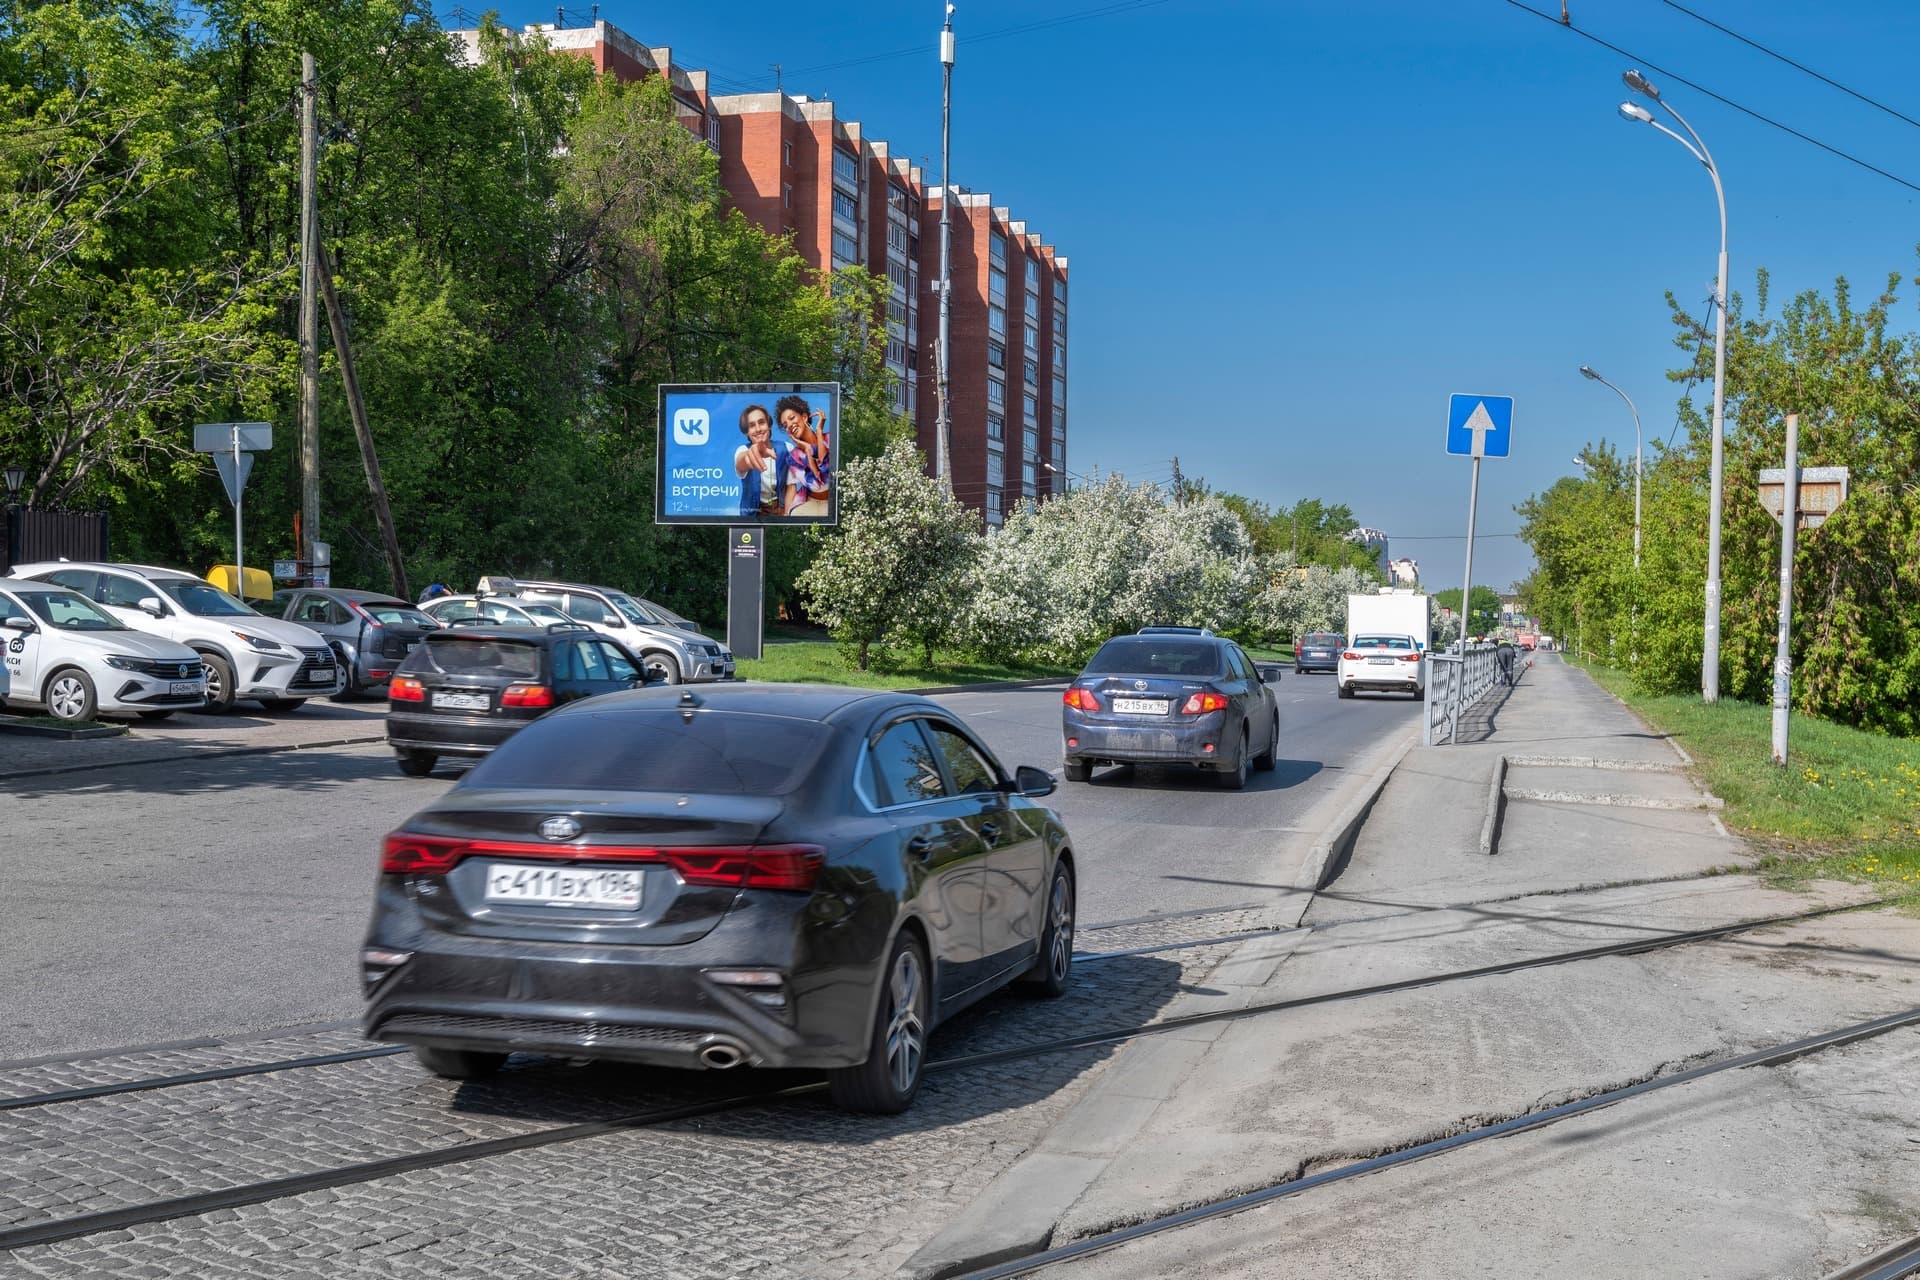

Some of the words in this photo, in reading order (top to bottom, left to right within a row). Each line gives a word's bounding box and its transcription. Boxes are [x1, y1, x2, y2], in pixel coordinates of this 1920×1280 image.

[680, 419, 703, 435] VK
[673, 468, 723, 479] место
[672, 485, 739, 500] встречи
[672, 502, 690, 512] 12+
[11, 640, 23, 651] Go
